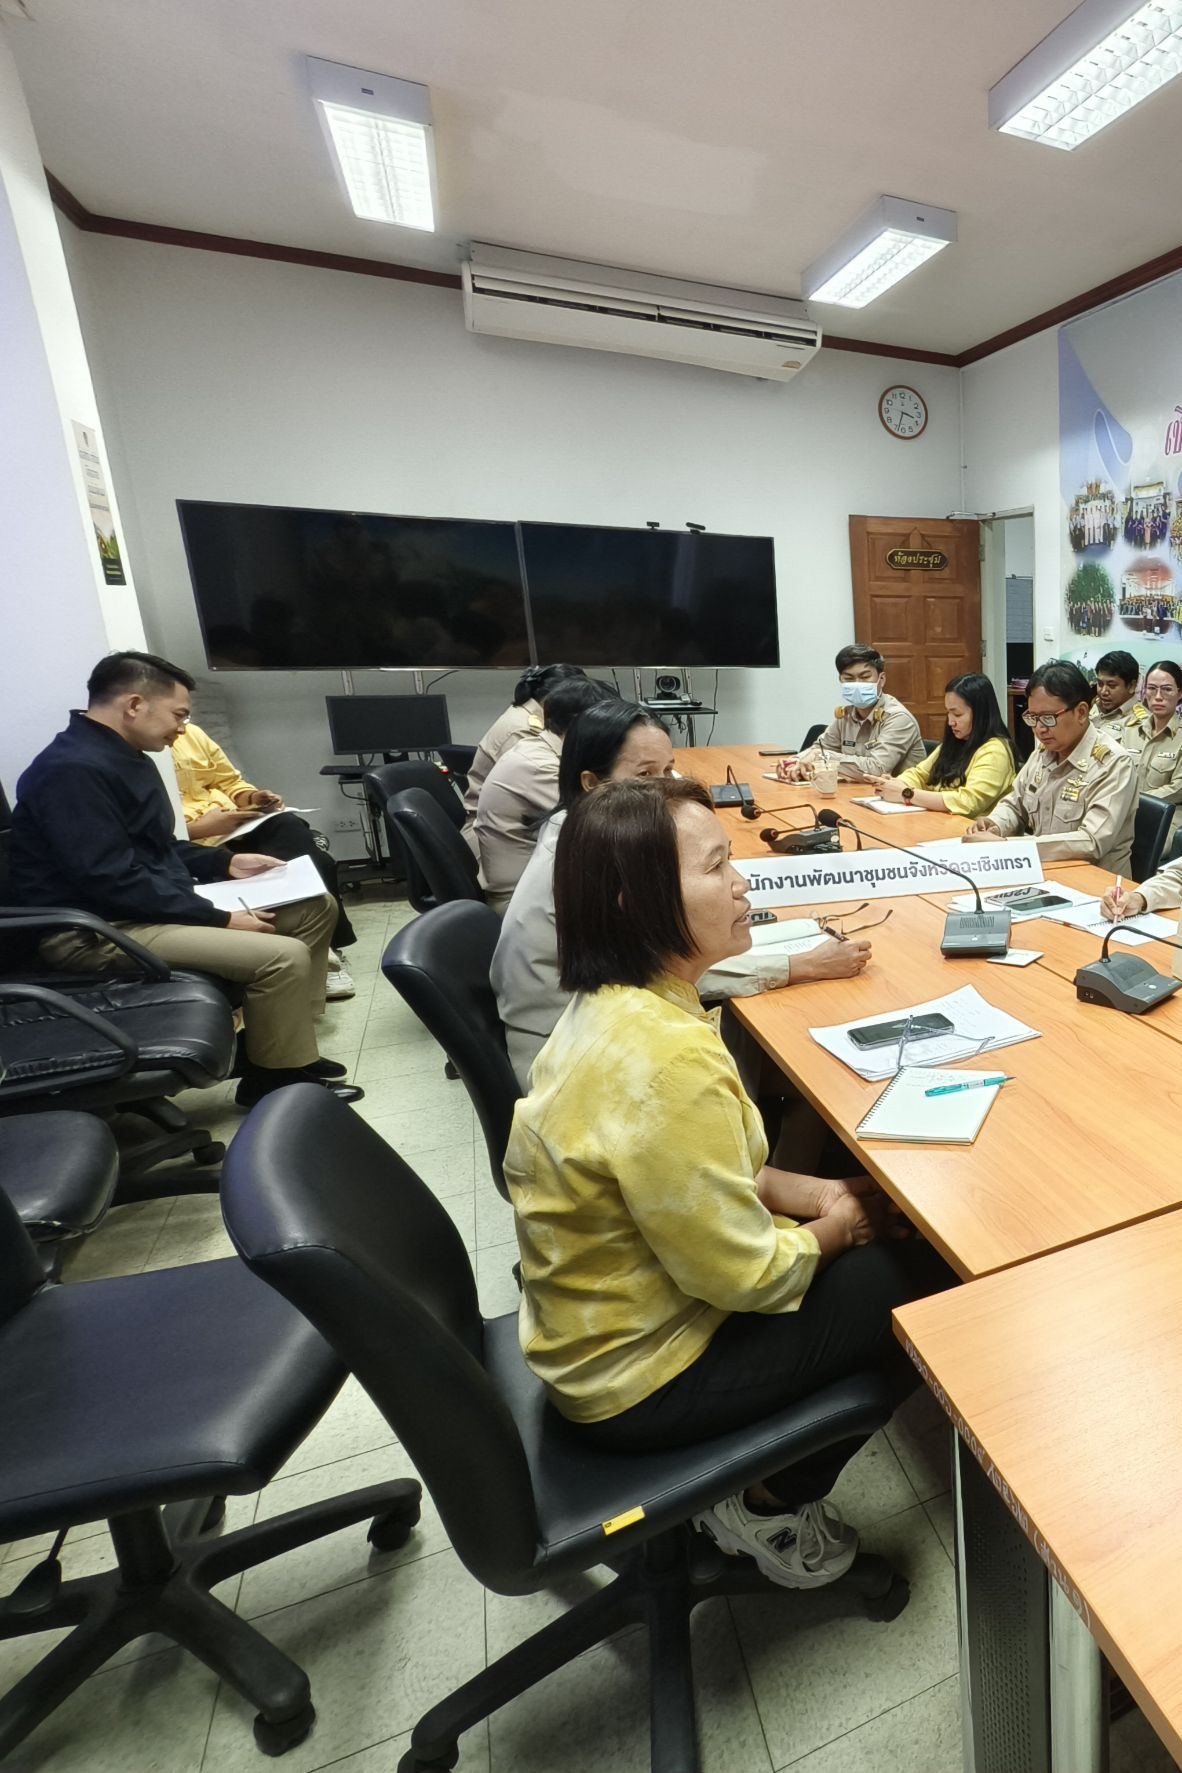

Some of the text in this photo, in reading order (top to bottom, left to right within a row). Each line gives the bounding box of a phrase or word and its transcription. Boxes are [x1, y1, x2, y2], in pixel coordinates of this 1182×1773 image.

[747, 856, 1032, 892] นักงานพัฒนาชุมชนจังหวัดฉะเชิงเทรา
